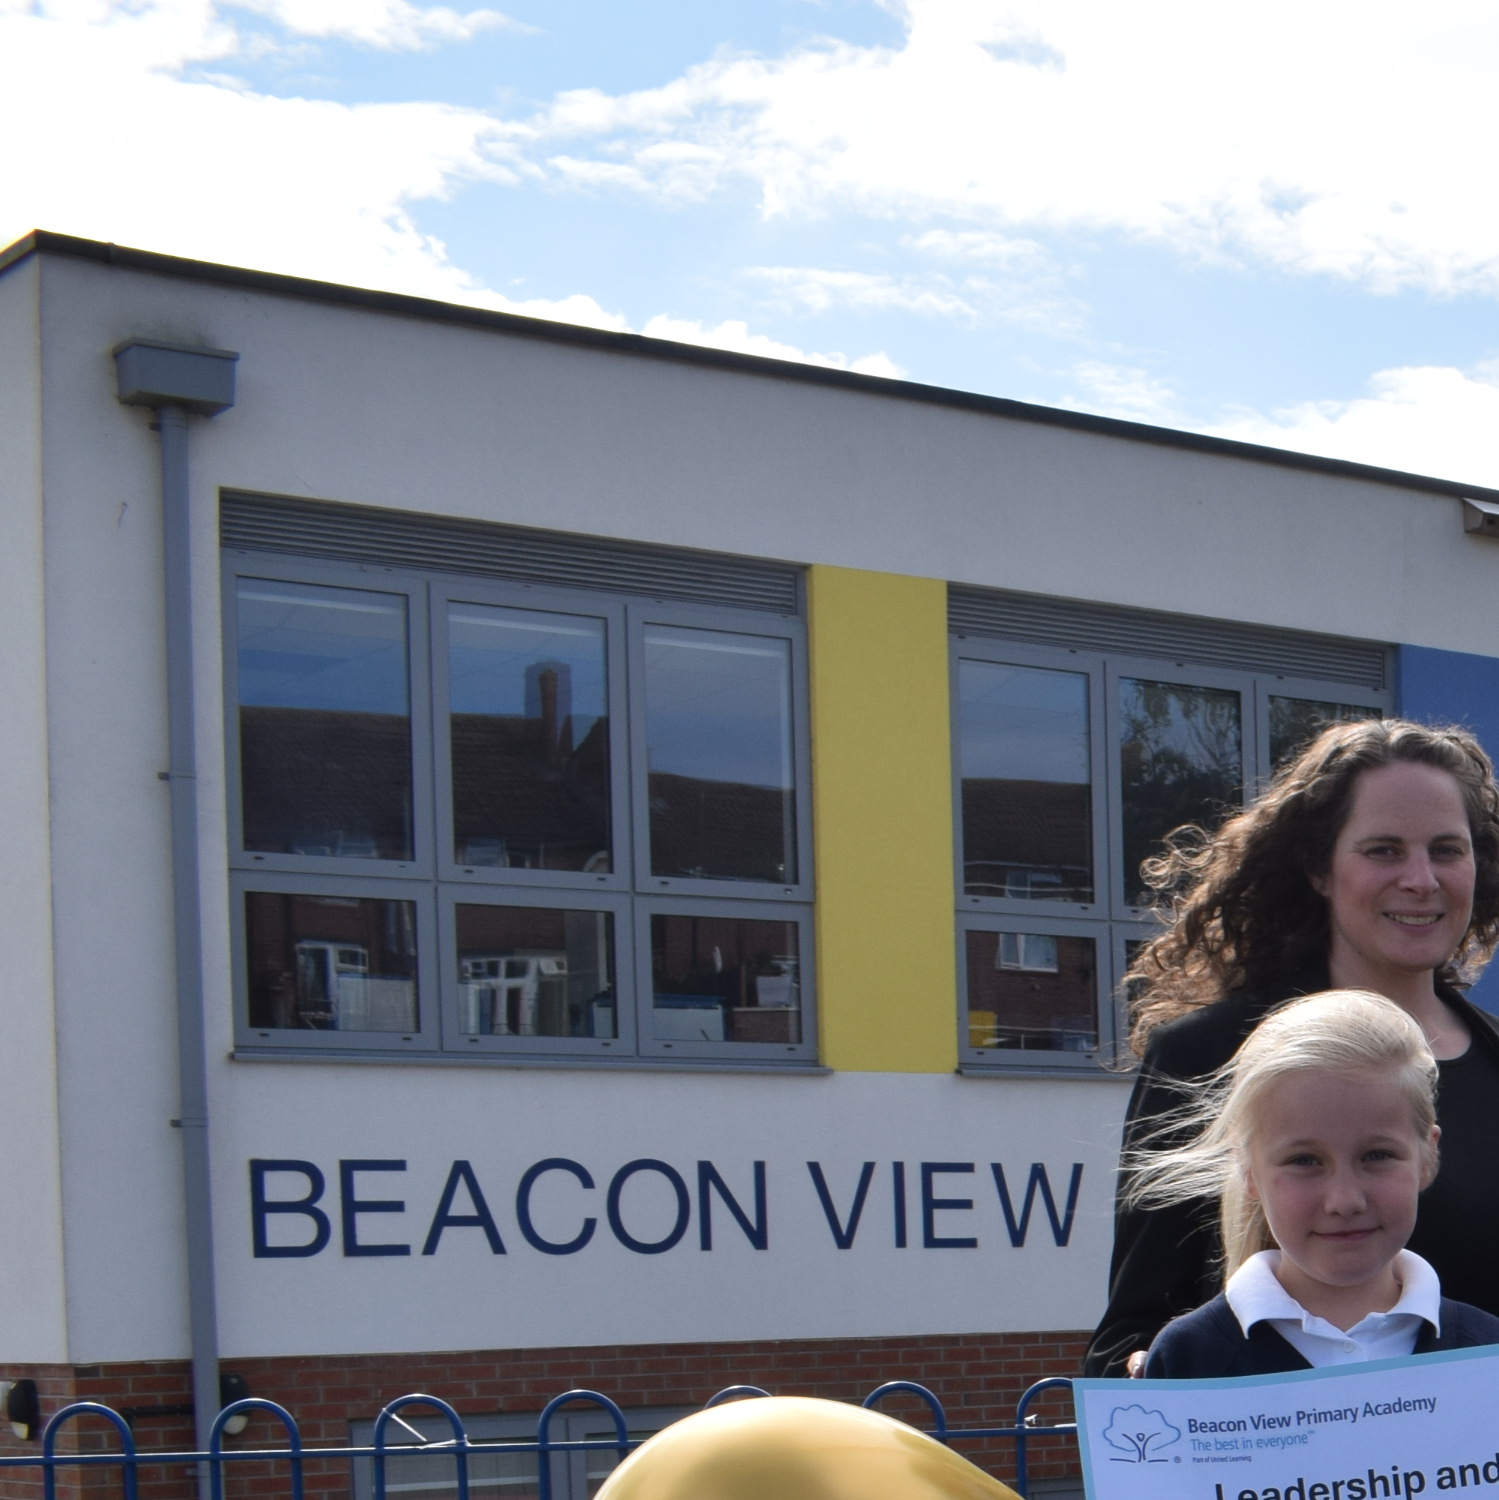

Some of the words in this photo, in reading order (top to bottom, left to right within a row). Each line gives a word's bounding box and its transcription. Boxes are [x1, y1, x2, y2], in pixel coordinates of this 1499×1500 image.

[249, 1157, 768, 1258] BEACON
[806, 1161, 1084, 1250] VIEW
[1188, 1418, 1247, 1433] Beacon
[1250, 1414, 1291, 1430] View
[1296, 1407, 1359, 1426] Primary
[1362, 1397, 1437, 1418] Academy
[1190, 1439, 1211, 1451] The
[1214, 1438, 1239, 1450] best
[1243, 1437, 1253, 1449] in
